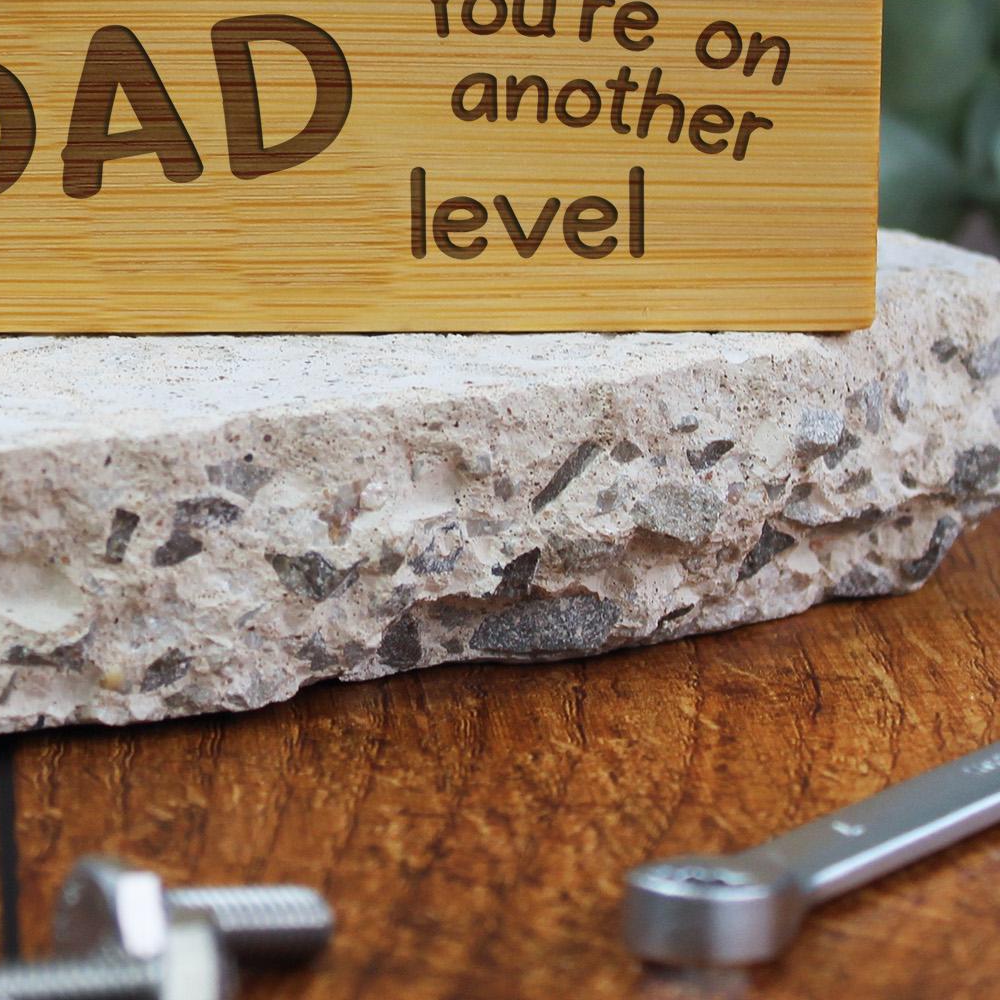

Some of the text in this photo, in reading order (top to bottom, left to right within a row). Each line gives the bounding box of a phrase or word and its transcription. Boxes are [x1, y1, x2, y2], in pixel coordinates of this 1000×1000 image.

[696, 20, 791, 86] on
[452, 65, 774, 161] another
[410, 166, 646, 259] level
